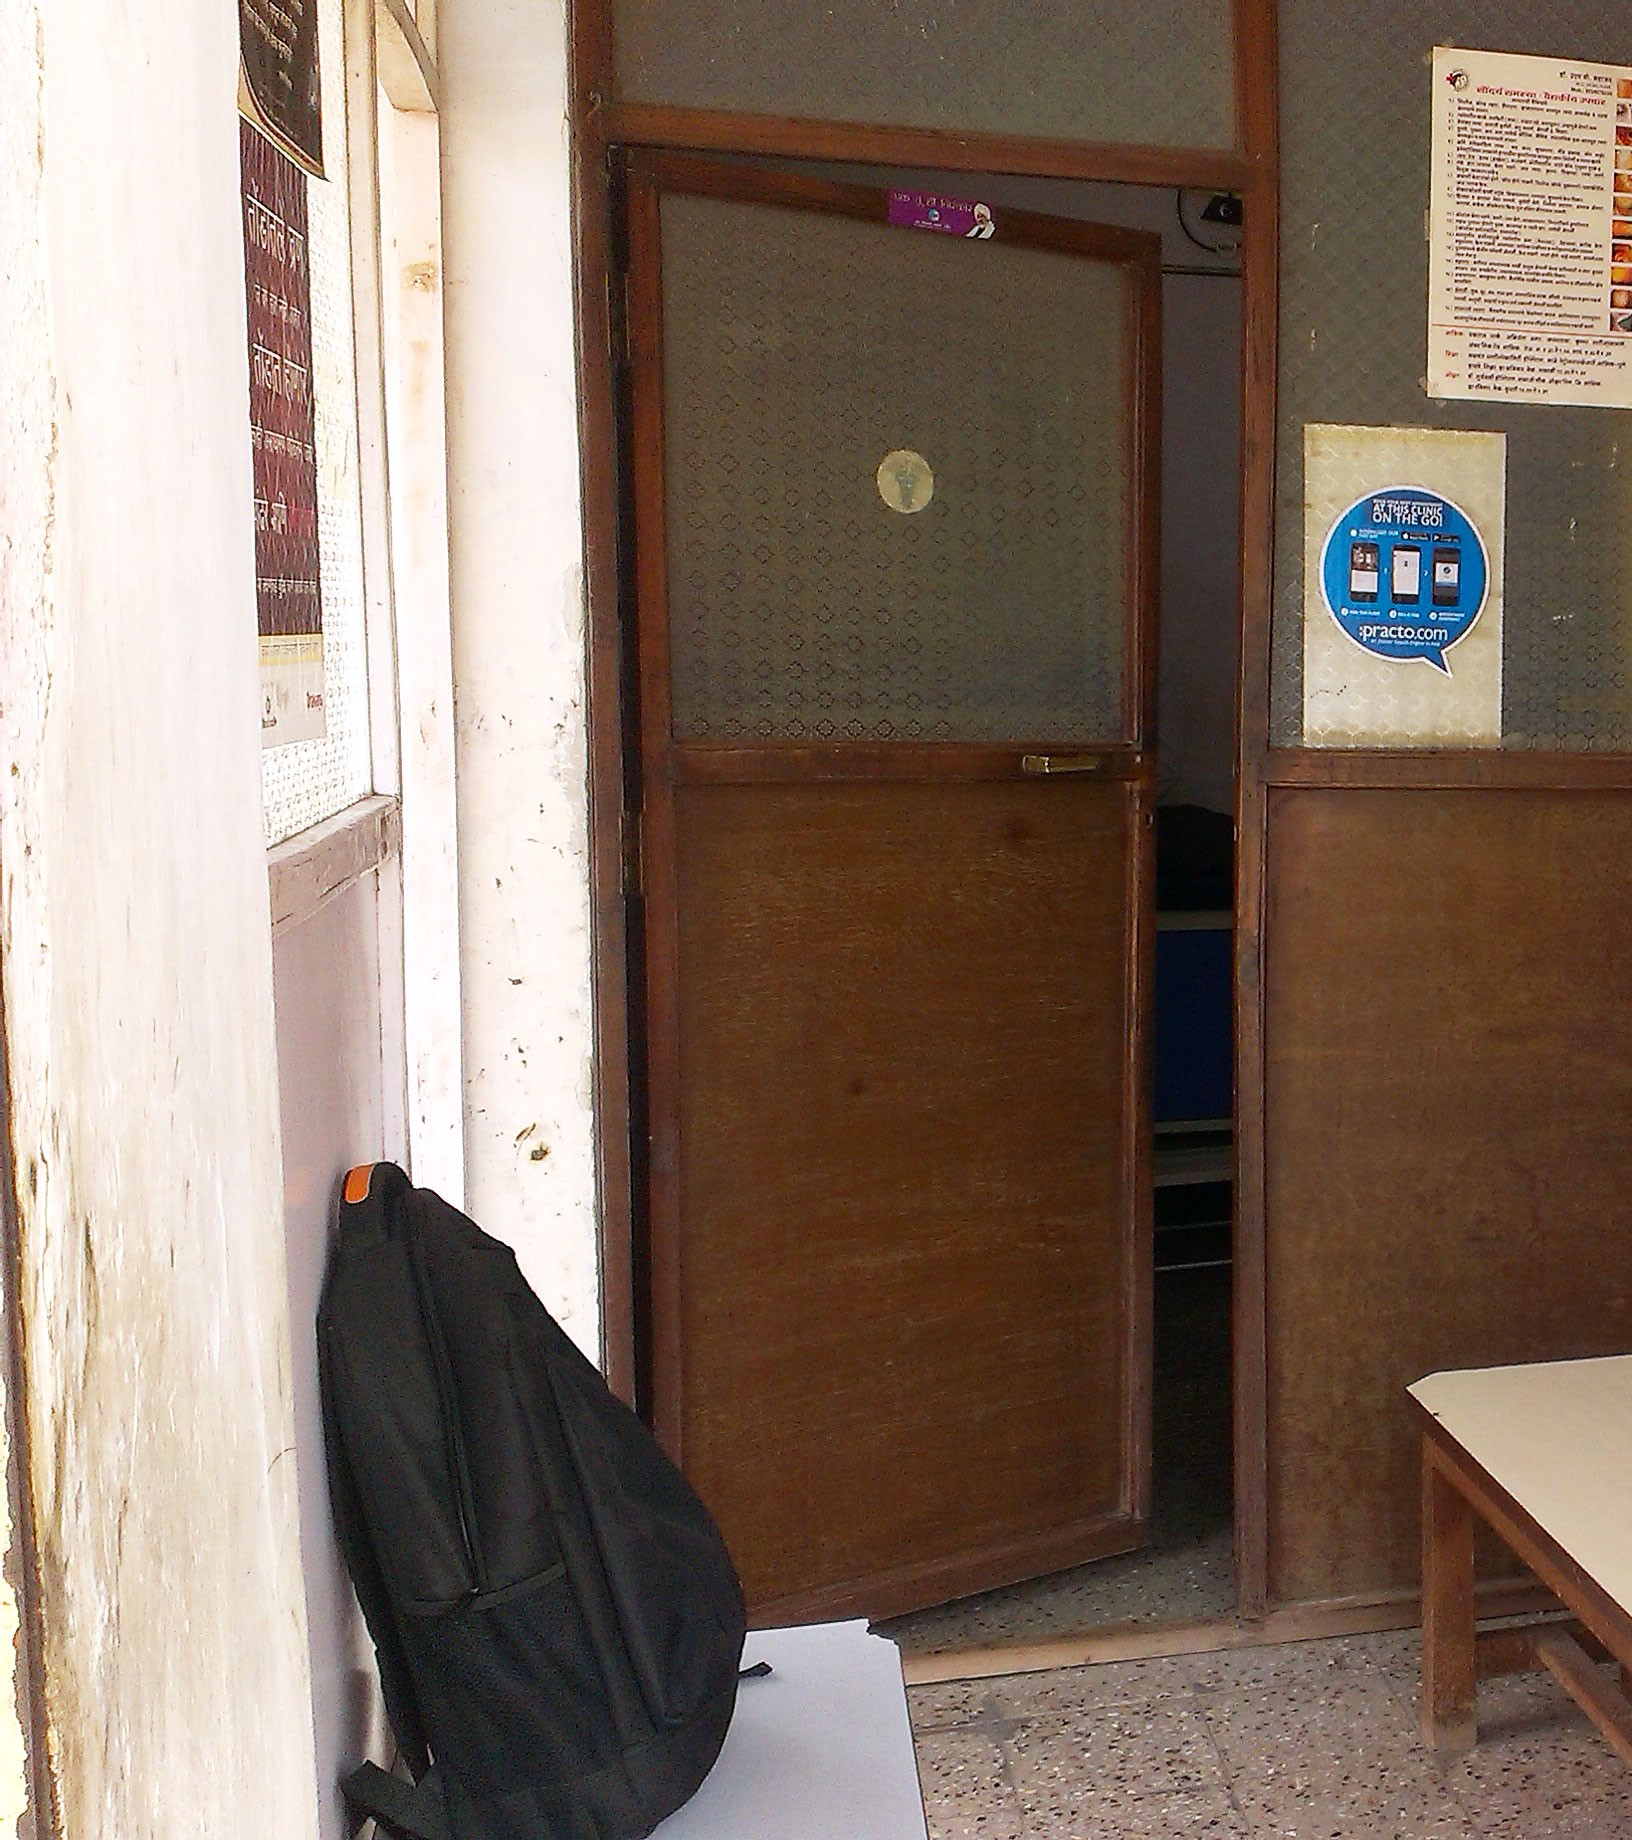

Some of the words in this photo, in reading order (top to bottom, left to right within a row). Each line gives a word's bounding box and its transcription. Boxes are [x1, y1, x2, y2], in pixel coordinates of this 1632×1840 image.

[1373, 503, 1385, 512] AT
[1387, 504, 1409, 515] THIS
[1411, 505, 1443, 517] CLINIC
[1372, 511, 1392, 524] ON
[1395, 513, 1418, 526] THE
[1421, 514, 1443, 527] GO!
